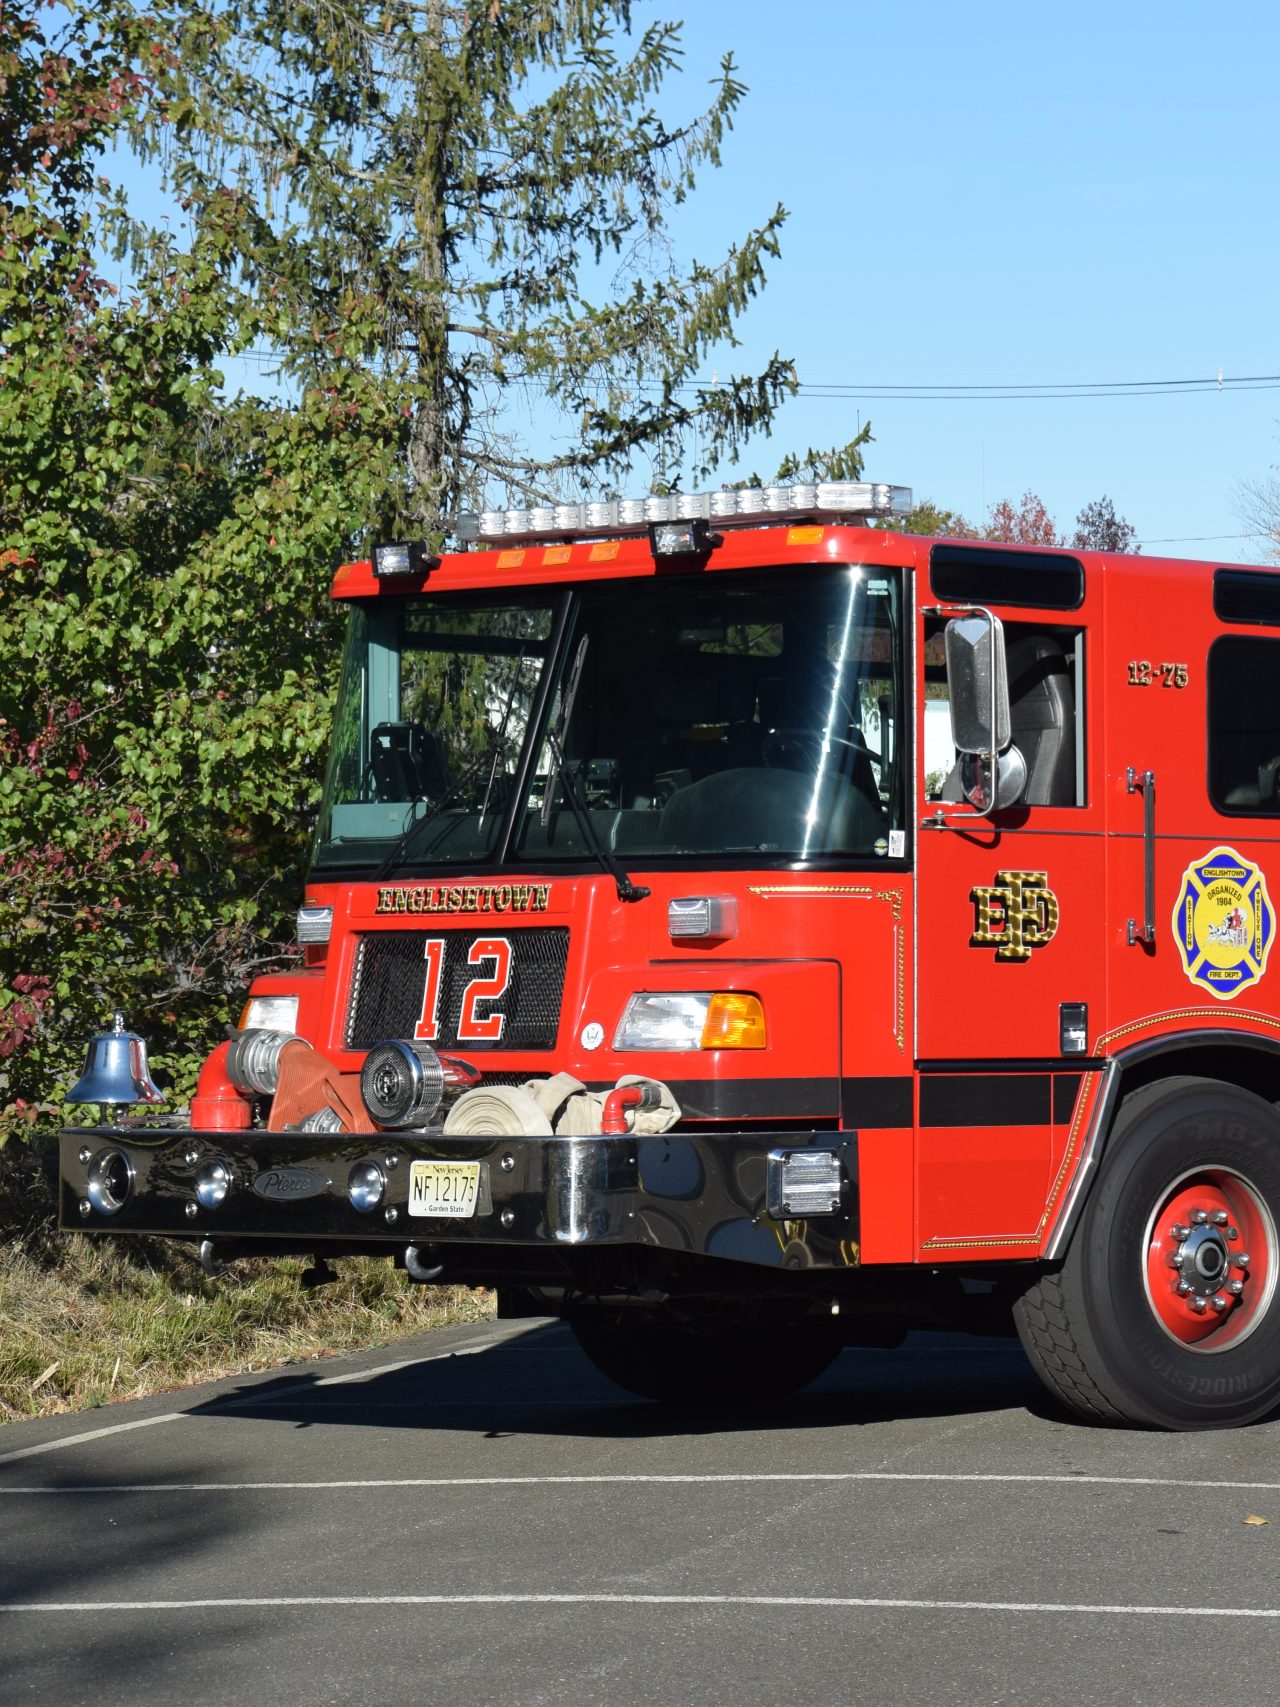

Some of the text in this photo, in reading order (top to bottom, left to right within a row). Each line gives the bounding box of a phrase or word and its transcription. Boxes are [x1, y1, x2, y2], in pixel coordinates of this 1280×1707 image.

[1127, 661, 1189, 689] 12-75
[1203, 869, 1245, 877] ENGLISHTOWN
[375, 884, 552, 914] ENGLISHTOWN
[1207, 885, 1242, 902] ORGANIZED
[1216, 898, 1232, 907] 1904
[1209, 970, 1241, 978] FIRE DEPT.
[414, 937, 512, 1040] 12
[433, 1164, 463, 1175] New Jersey
[264, 1172, 312, 1194] Pierce
[414, 1176, 475, 1202] NF12175
[450, 1205, 464, 1213] State
